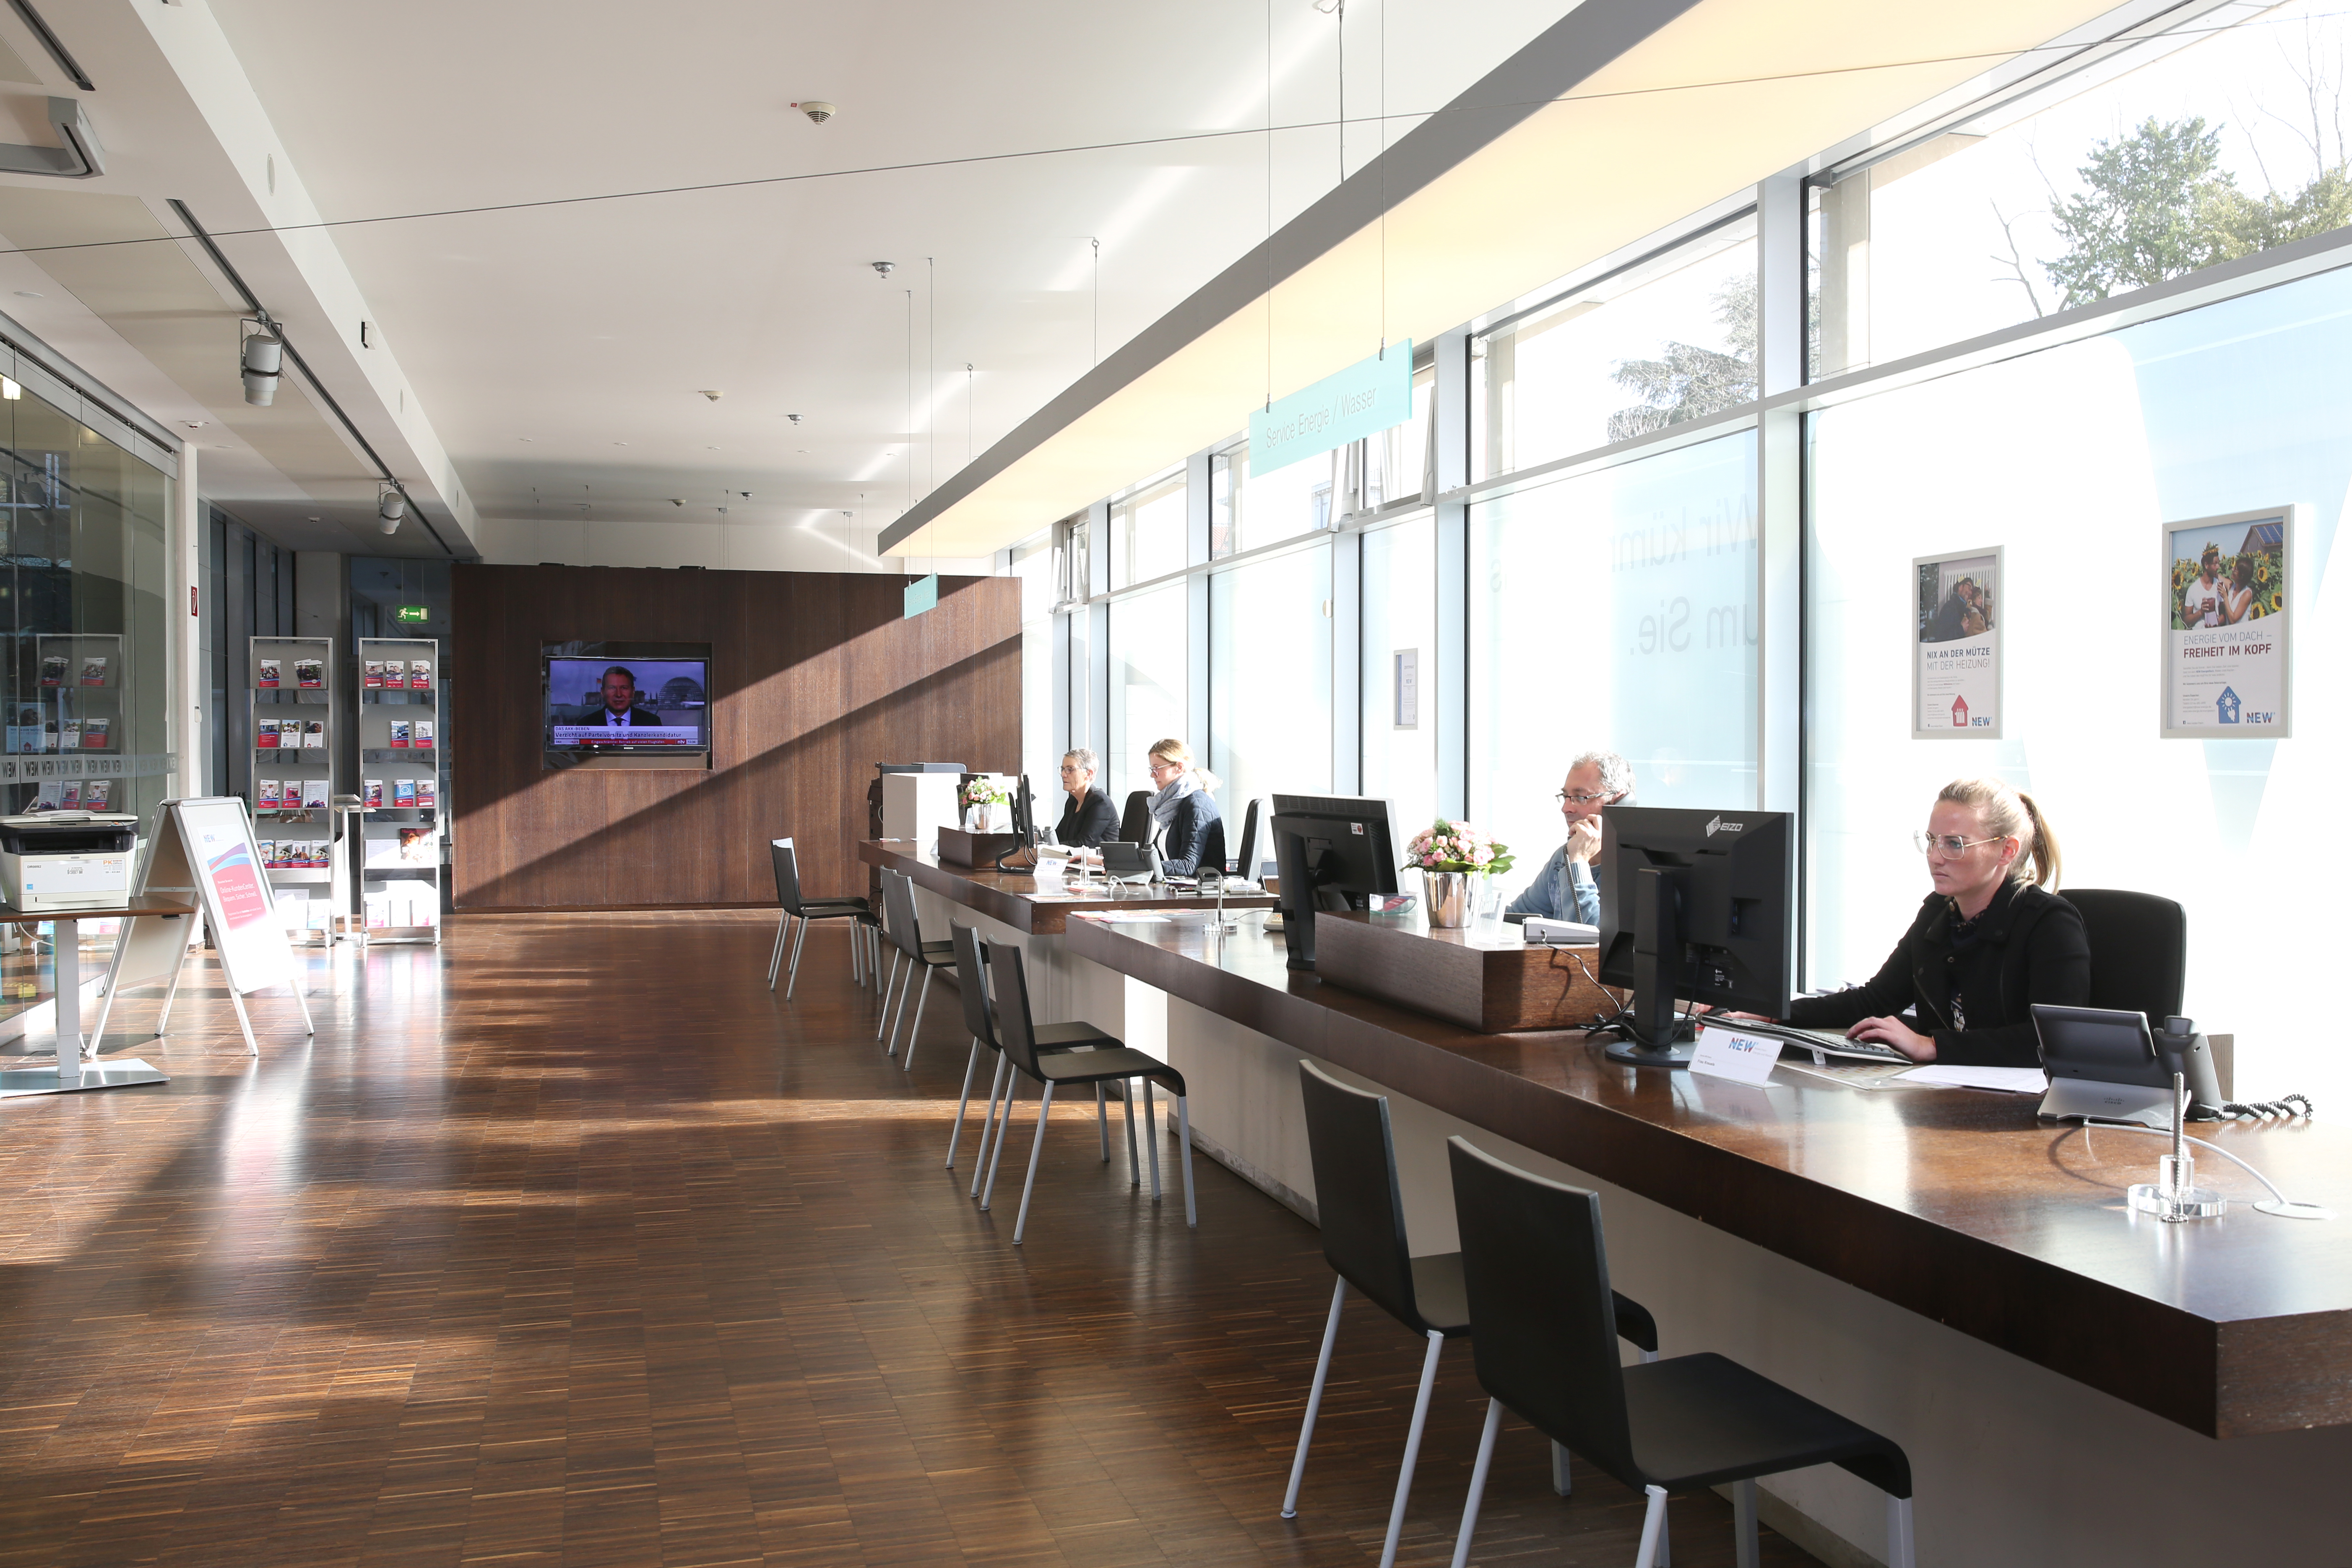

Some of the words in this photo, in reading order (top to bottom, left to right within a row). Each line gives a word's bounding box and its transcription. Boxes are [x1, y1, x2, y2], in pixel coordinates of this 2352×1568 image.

[1266, 421, 1296, 449] Service
[1298, 404, 1330, 436] Energie
[1332, 395, 1339, 425] /
[1341, 387, 1377, 418] Wasser
[2184, 634, 2217, 645] ENERGIE
[2219, 632, 2237, 642] VOM
[2240, 631, 2263, 642] DACH
[1927, 651, 1937, 659] NIX
[1951, 649, 1964, 658] DER
[1966, 646, 1990, 657] MÜTZE
[2184, 646, 2225, 658] FREIHEIT
[2229, 645, 2240, 656] IM
[2245, 643, 2272, 655] KOPF
[1927, 661, 1938, 671] MIT
[1941, 660, 1954, 670] DER
[1956, 658, 1990, 669] HEIZUNG!
[1972, 717, 1990, 727] NEW
[2246, 712, 2273, 723] NEW
[1720, 822, 1743, 832] EIZO
[203, 834, 216, 843] NEW
[1728, 1037, 1756, 1053] NEW
